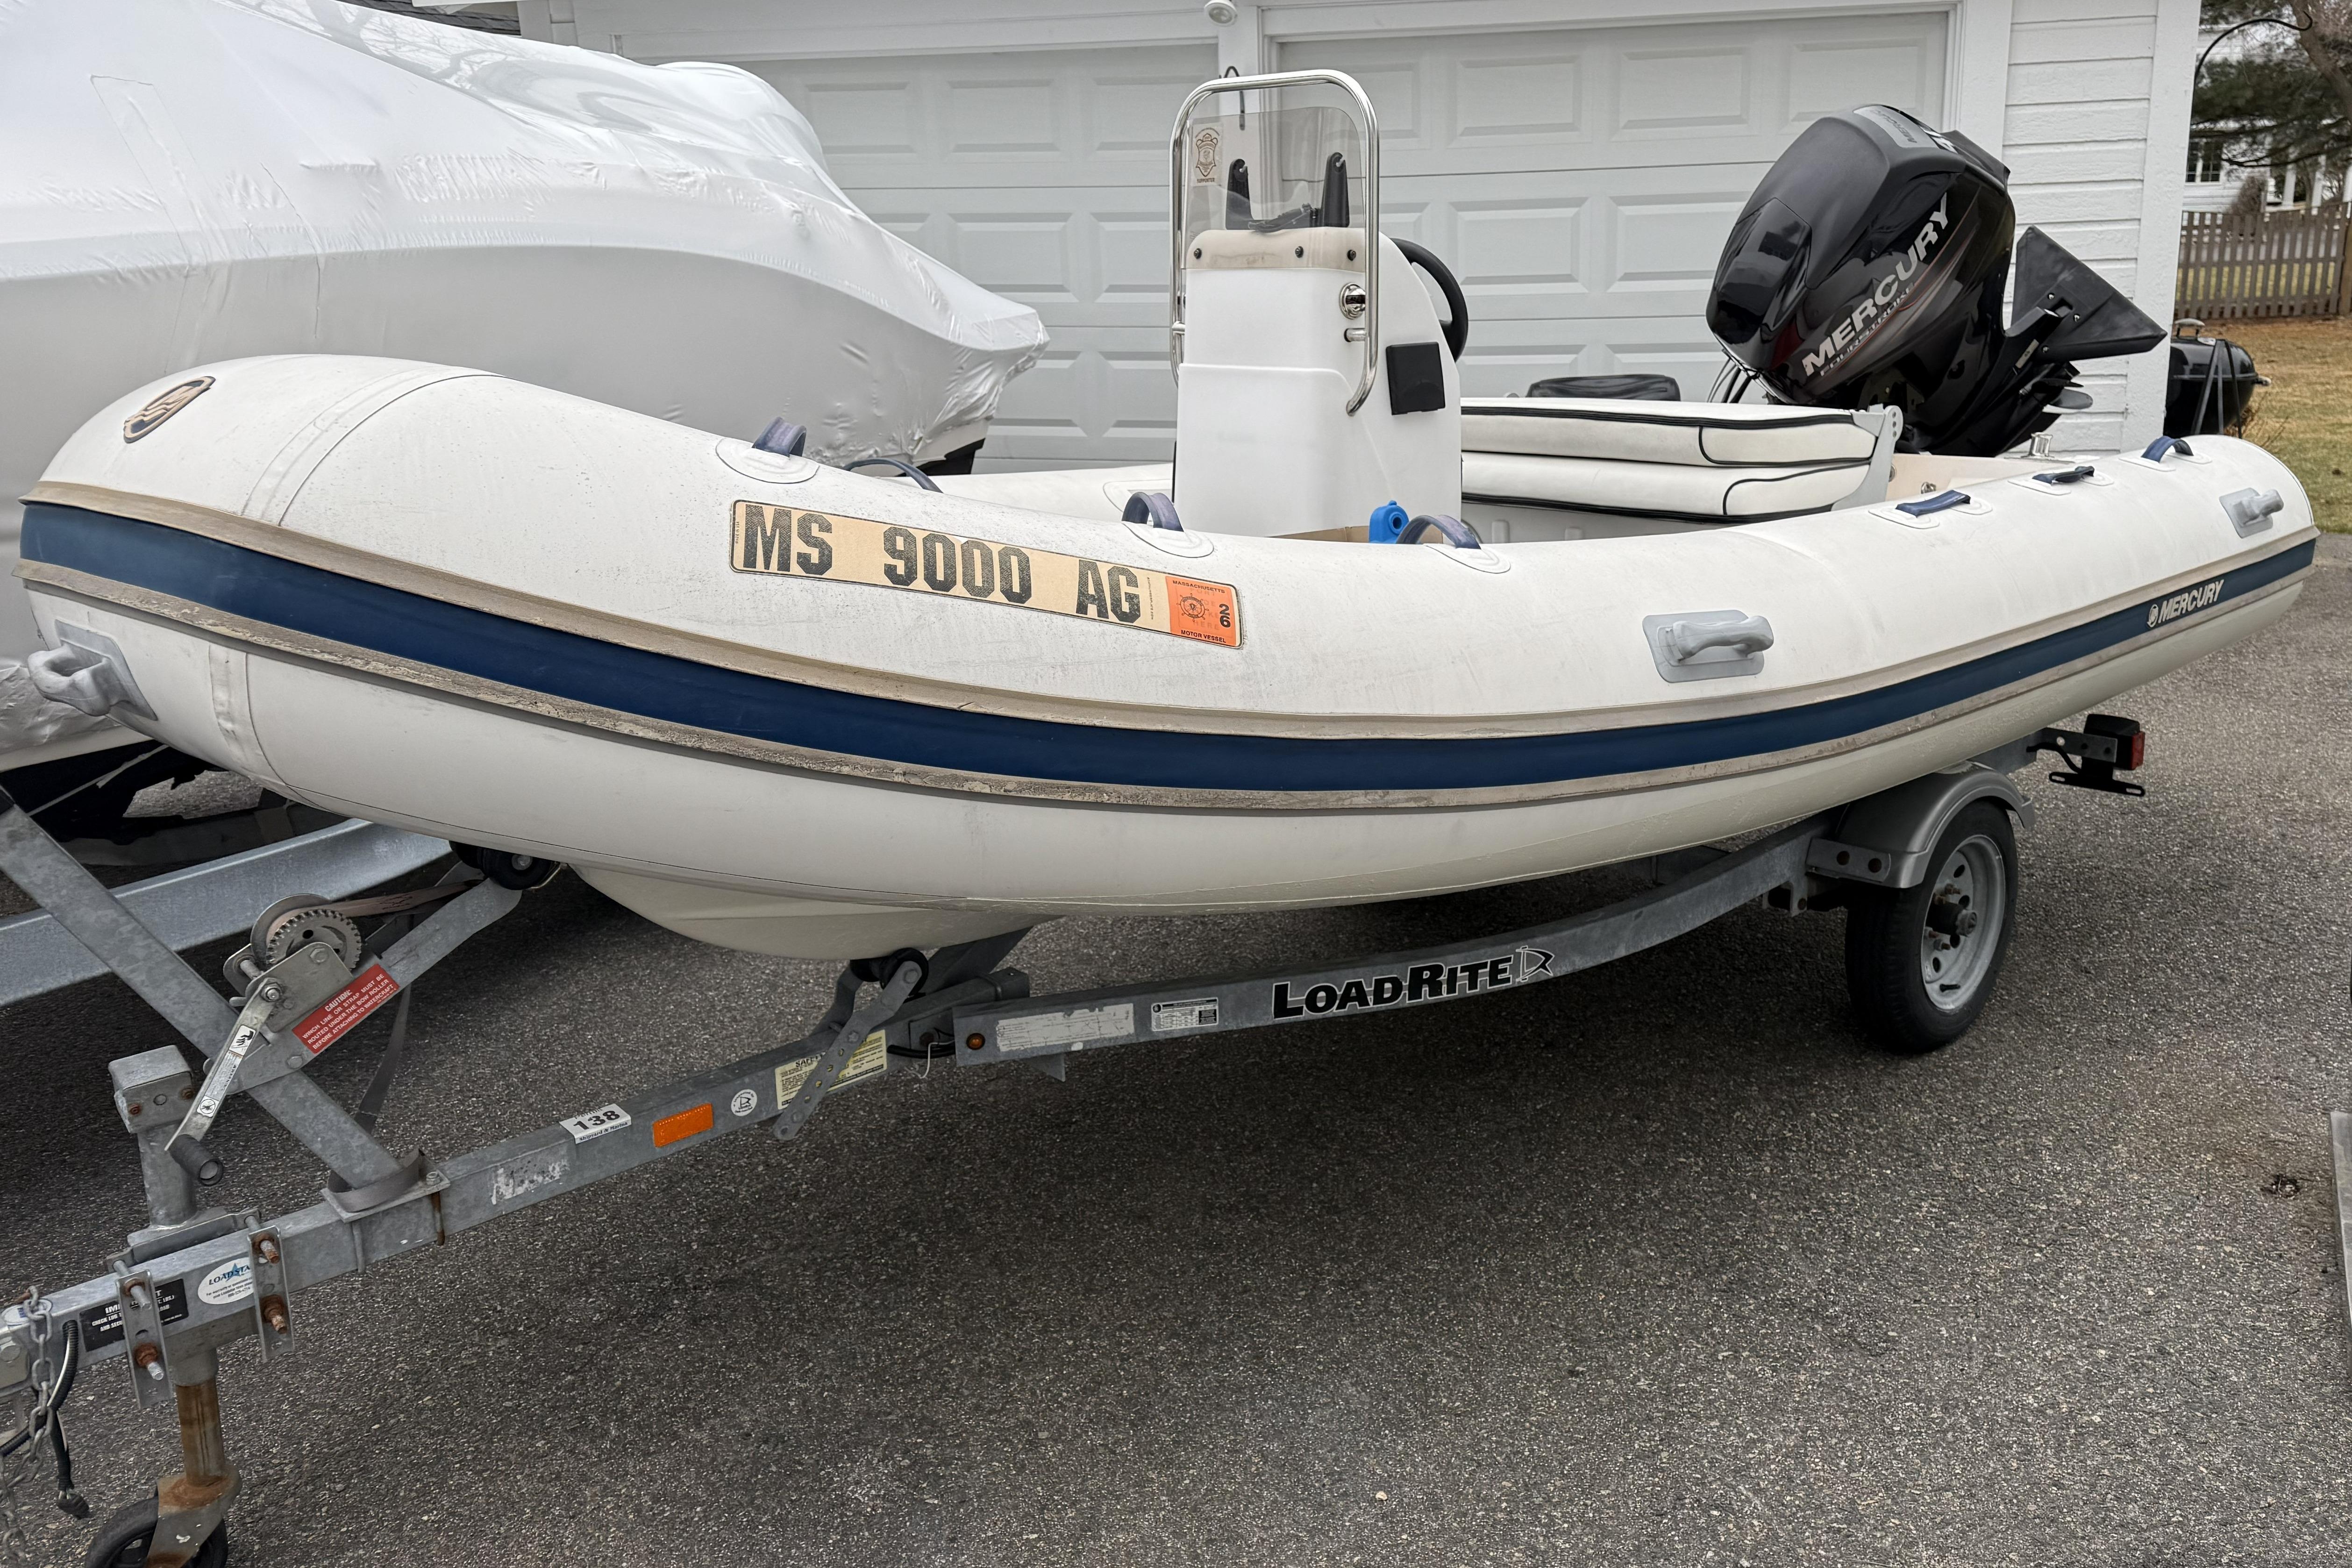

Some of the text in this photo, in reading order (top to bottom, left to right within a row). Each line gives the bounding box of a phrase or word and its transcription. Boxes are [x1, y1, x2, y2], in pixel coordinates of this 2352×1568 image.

[1802, 192, 1948, 377] MERCURY
[743, 505, 1141, 624] MS 9000 AG
[1172, 580, 1225, 593] MASSACHUSETTS
[2158, 579, 2224, 624] MERCURY
[1181, 629, 1226, 643] MOTOR VESSEL
[302, 1025, 320, 1039] WINCH
[320, 1014, 333, 1025] LINE
[334, 1006, 343, 1015] OR
[343, 992, 360, 1007] STRAP
[361, 980, 375, 993] MUST
[307, 1027, 328, 1044] ROUTED
[328, 1013, 347, 1028] UNDER
[346, 1005, 357, 1014] THE
[356, 995, 369, 1005] BOW
[369, 979, 389, 996] ROLLER
[325, 989, 353, 1012] CAUTION:
[312, 1033, 333, 1050] BEFORE
[332, 1013, 358, 1034] ATTACHING
[363, 984, 393, 1009] WATERCRAFT
[573, 1110, 620, 1130] 138
[579, 1130, 603, 1142] Shipyard
[610, 1122, 628, 1131] Marina
[209, 1264, 250, 1285] LOADSTA
[92, 1317, 107, 1326] CHECK
